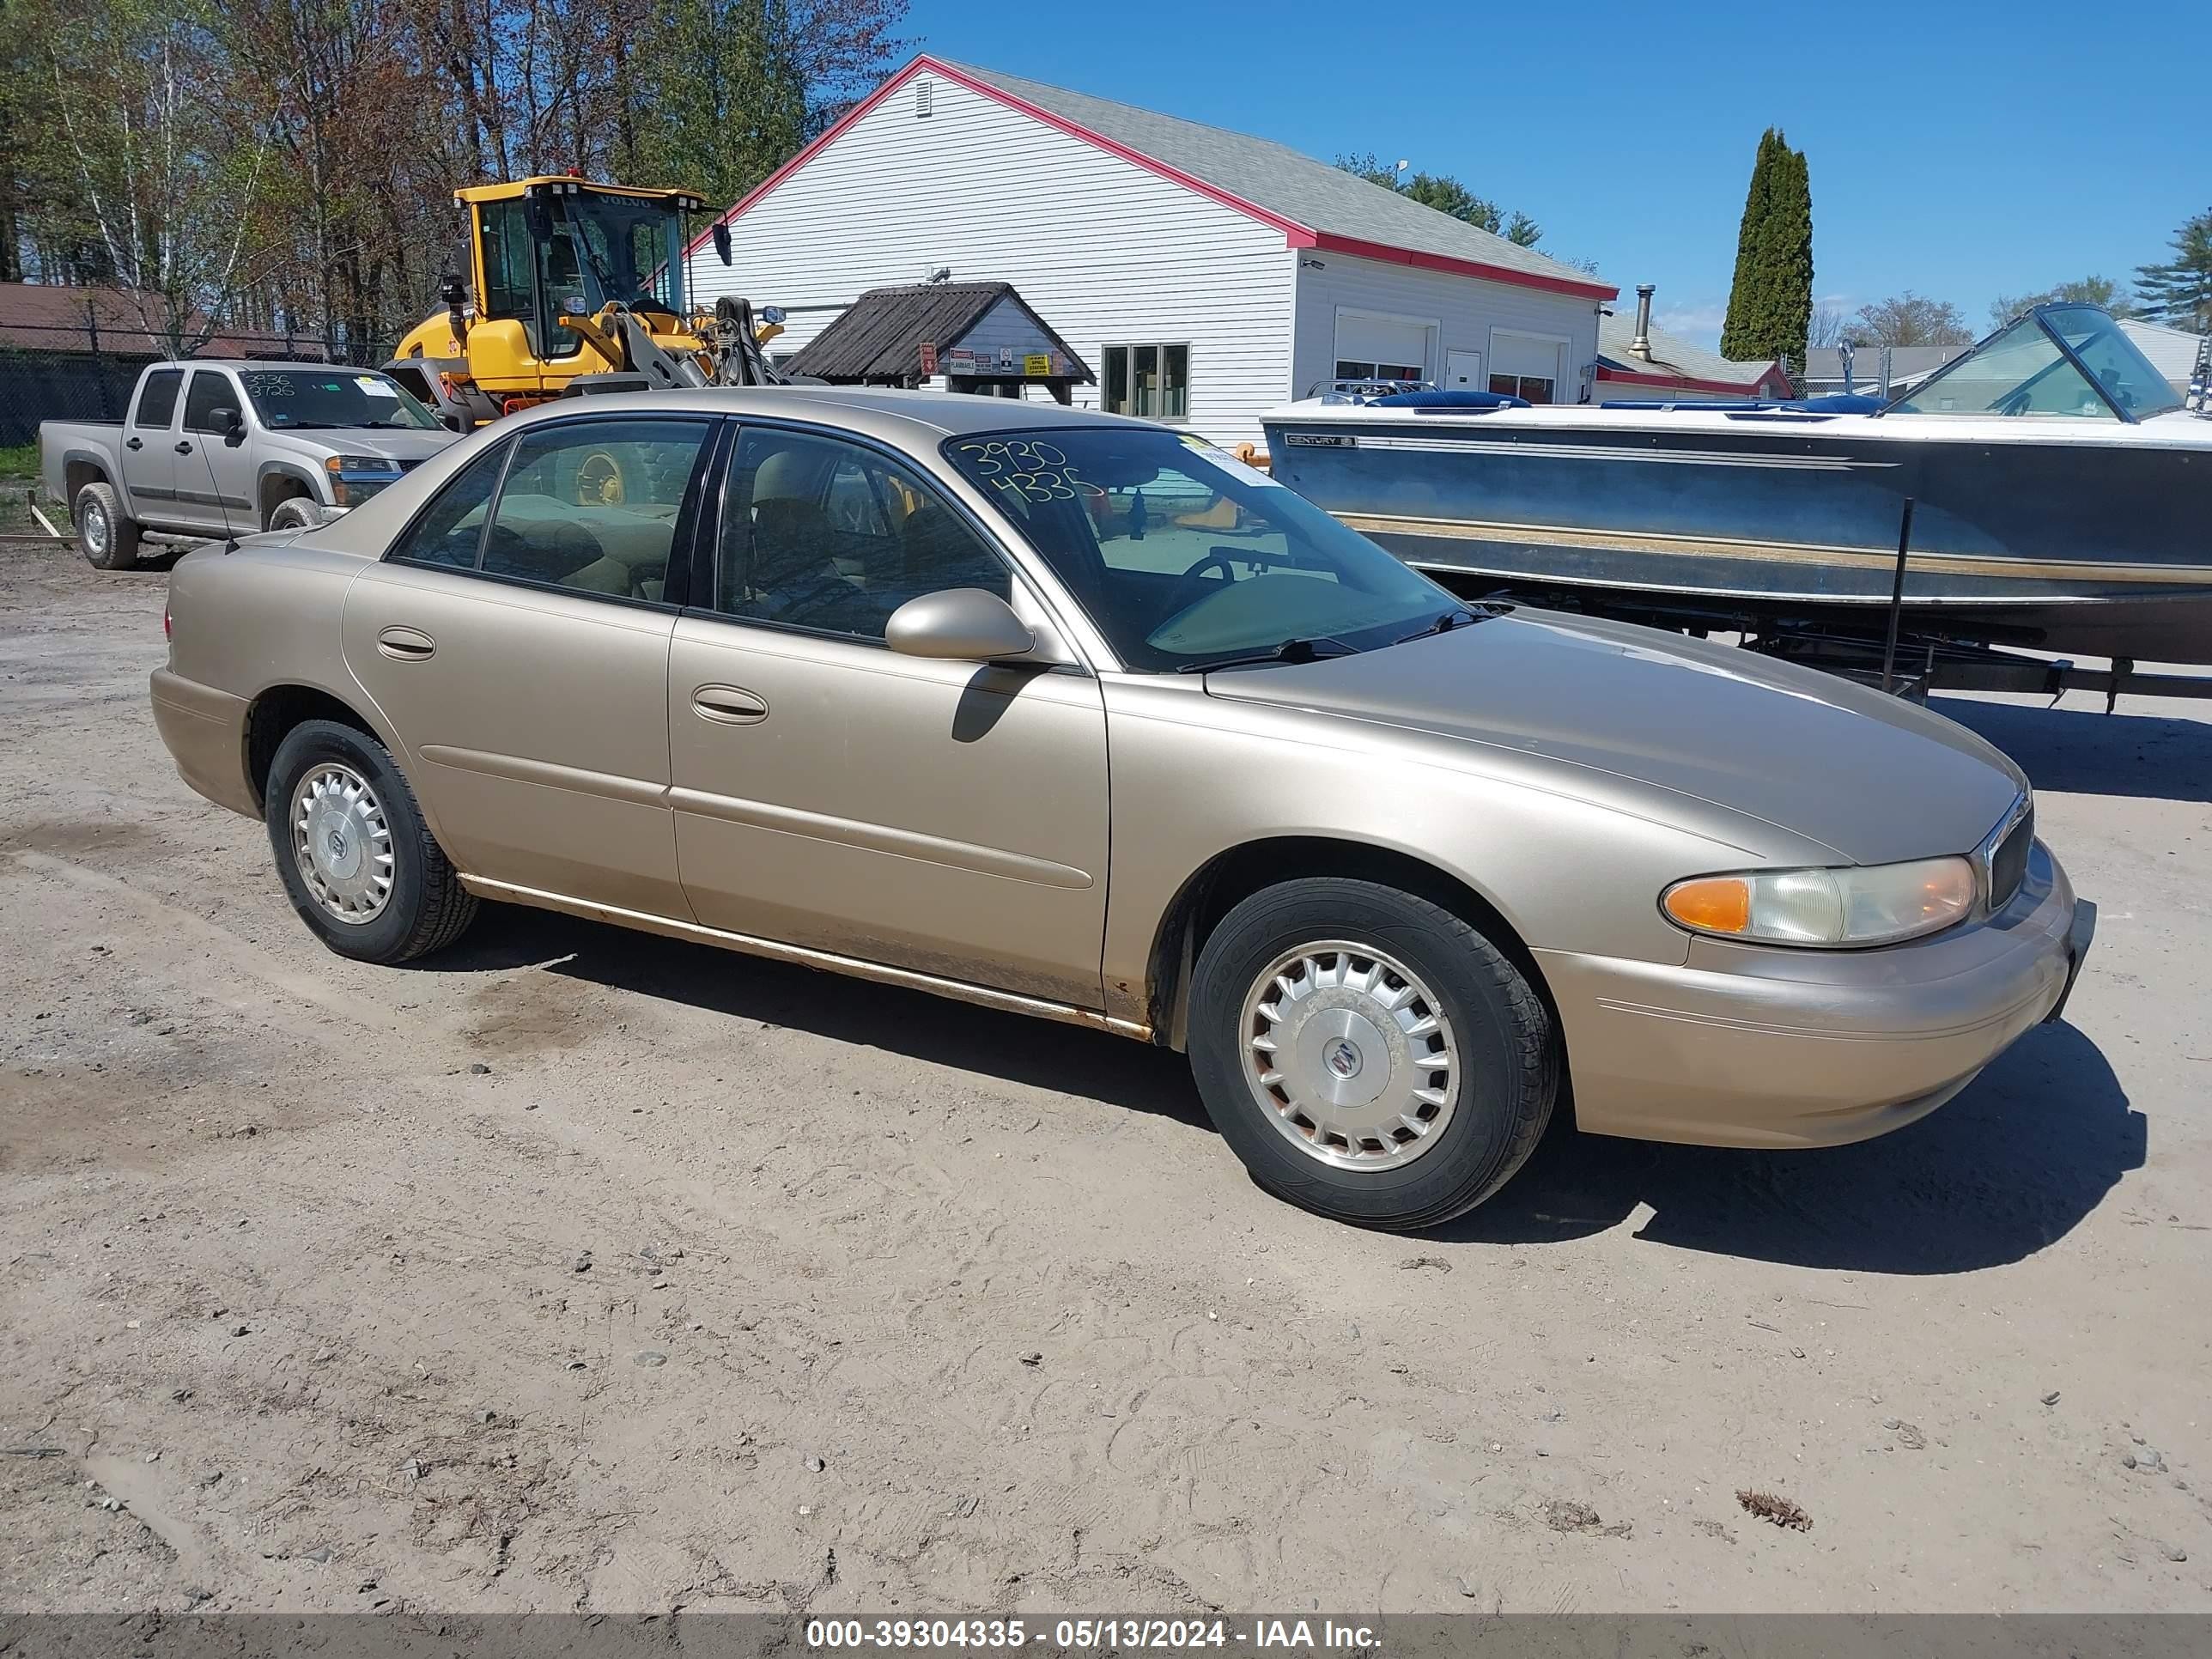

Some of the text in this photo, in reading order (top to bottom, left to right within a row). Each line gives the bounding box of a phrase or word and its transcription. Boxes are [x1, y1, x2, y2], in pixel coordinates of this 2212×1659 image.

[600, 195, 651, 208] VOLVO
[246, 374, 291, 386] 3936
[249, 386, 295, 398] 3726
[1288, 436, 1336, 445] CENTURY
[960, 441, 1066, 474] 3930
[991, 467, 1105, 503] 4335
